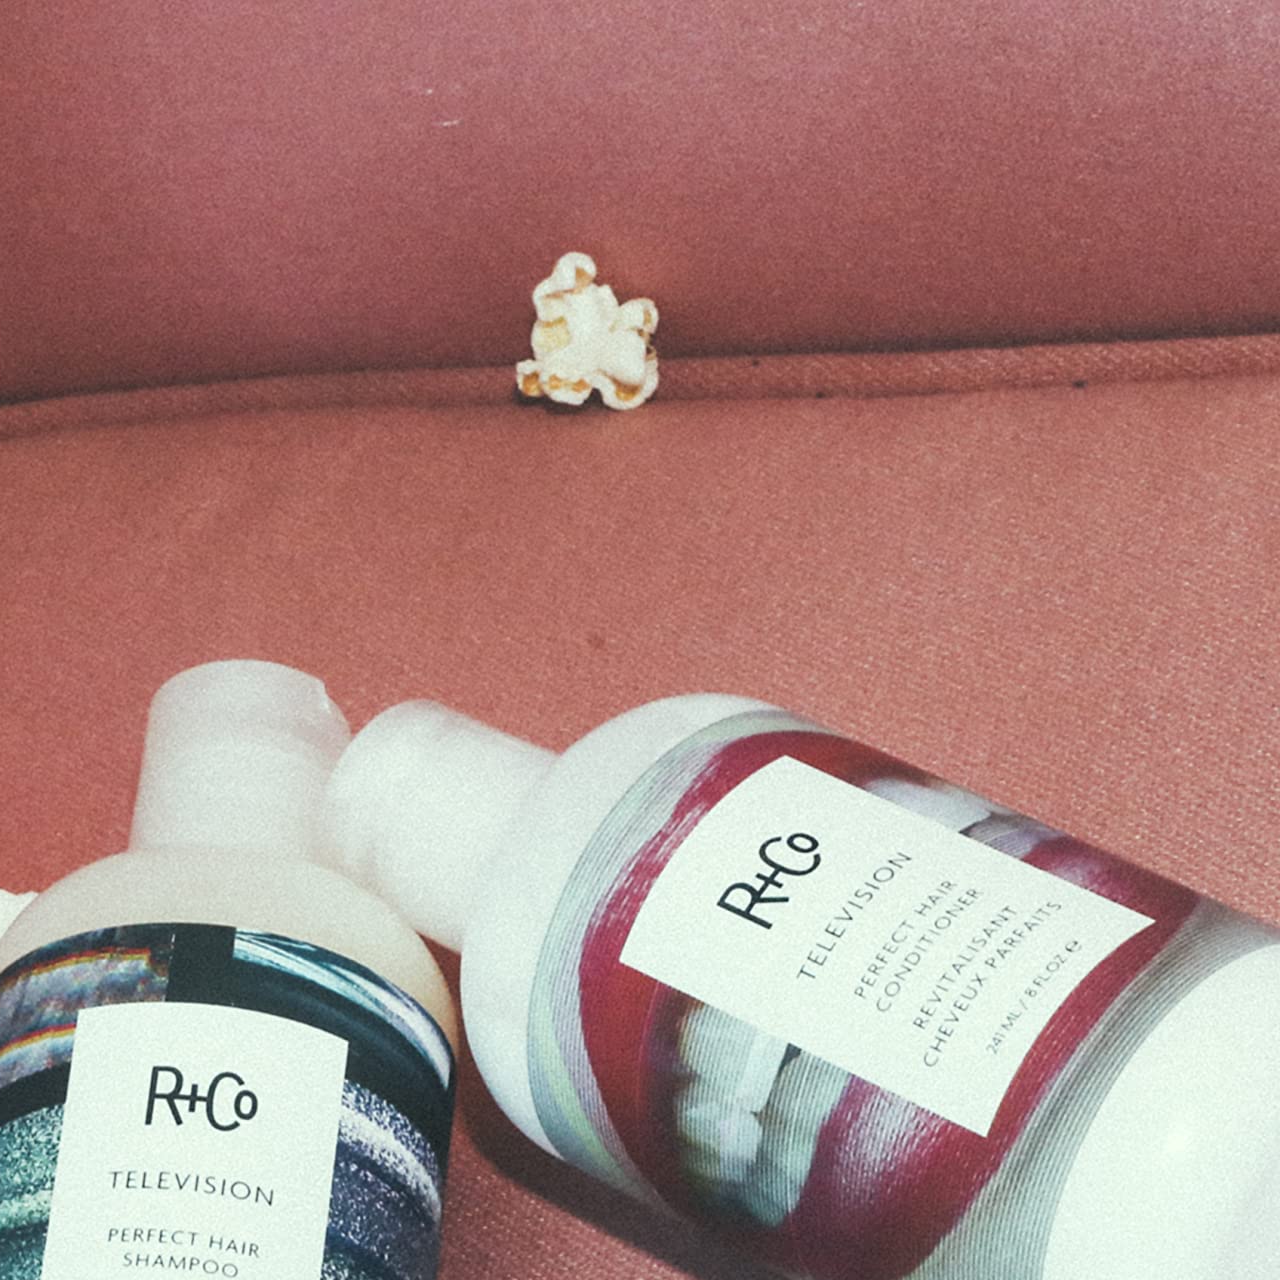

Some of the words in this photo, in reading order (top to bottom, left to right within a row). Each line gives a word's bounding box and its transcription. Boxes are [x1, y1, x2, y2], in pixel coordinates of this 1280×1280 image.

[716, 832, 822, 930] R+Co
[796, 852, 912, 980] TELEVISION
[854, 918, 915, 1000] PERFECT
[914, 879, 958, 917] HAIR
[875, 888, 985, 1013] CONDITIONER
[912, 905, 1018, 1030] REVITALISANT
[923, 973, 988, 1068] CHEVEUX
[984, 901, 1063, 969] PARFAITS
[1001, 1009, 1023, 1032] ML
[1024, 987, 1038, 998] 8
[144, 1065, 259, 1132] R+Co
[108, 1170, 275, 1207] TELEVISION
[107, 1227, 198, 1248] PERFECT
[208, 1234, 261, 1258] HAIR
[122, 1252, 240, 1279] SHAMPOO
